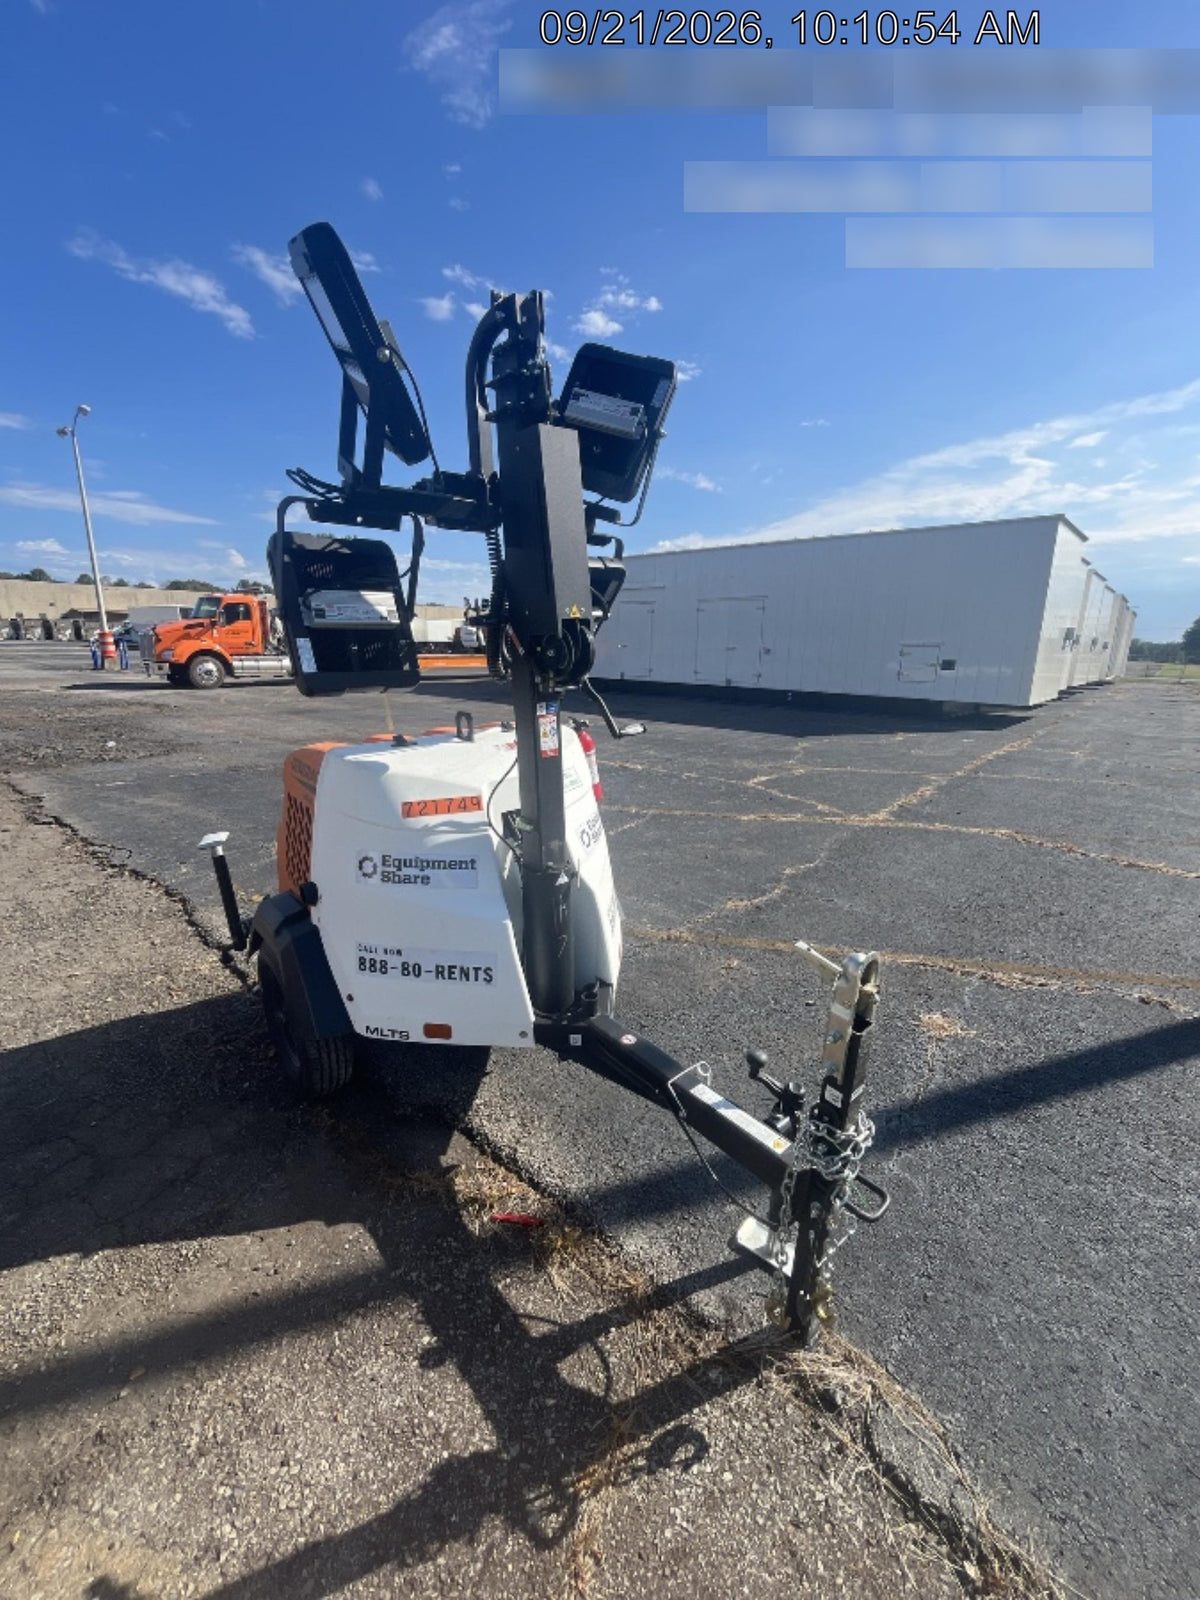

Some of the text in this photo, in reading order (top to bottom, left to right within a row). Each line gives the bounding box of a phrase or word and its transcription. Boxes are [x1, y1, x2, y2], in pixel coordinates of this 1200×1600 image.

[402, 796, 481, 818] 721749
[381, 854, 477, 872] Equipment
[380, 870, 431, 886] Share
[358, 955, 494, 983] 888-80-RENTS
